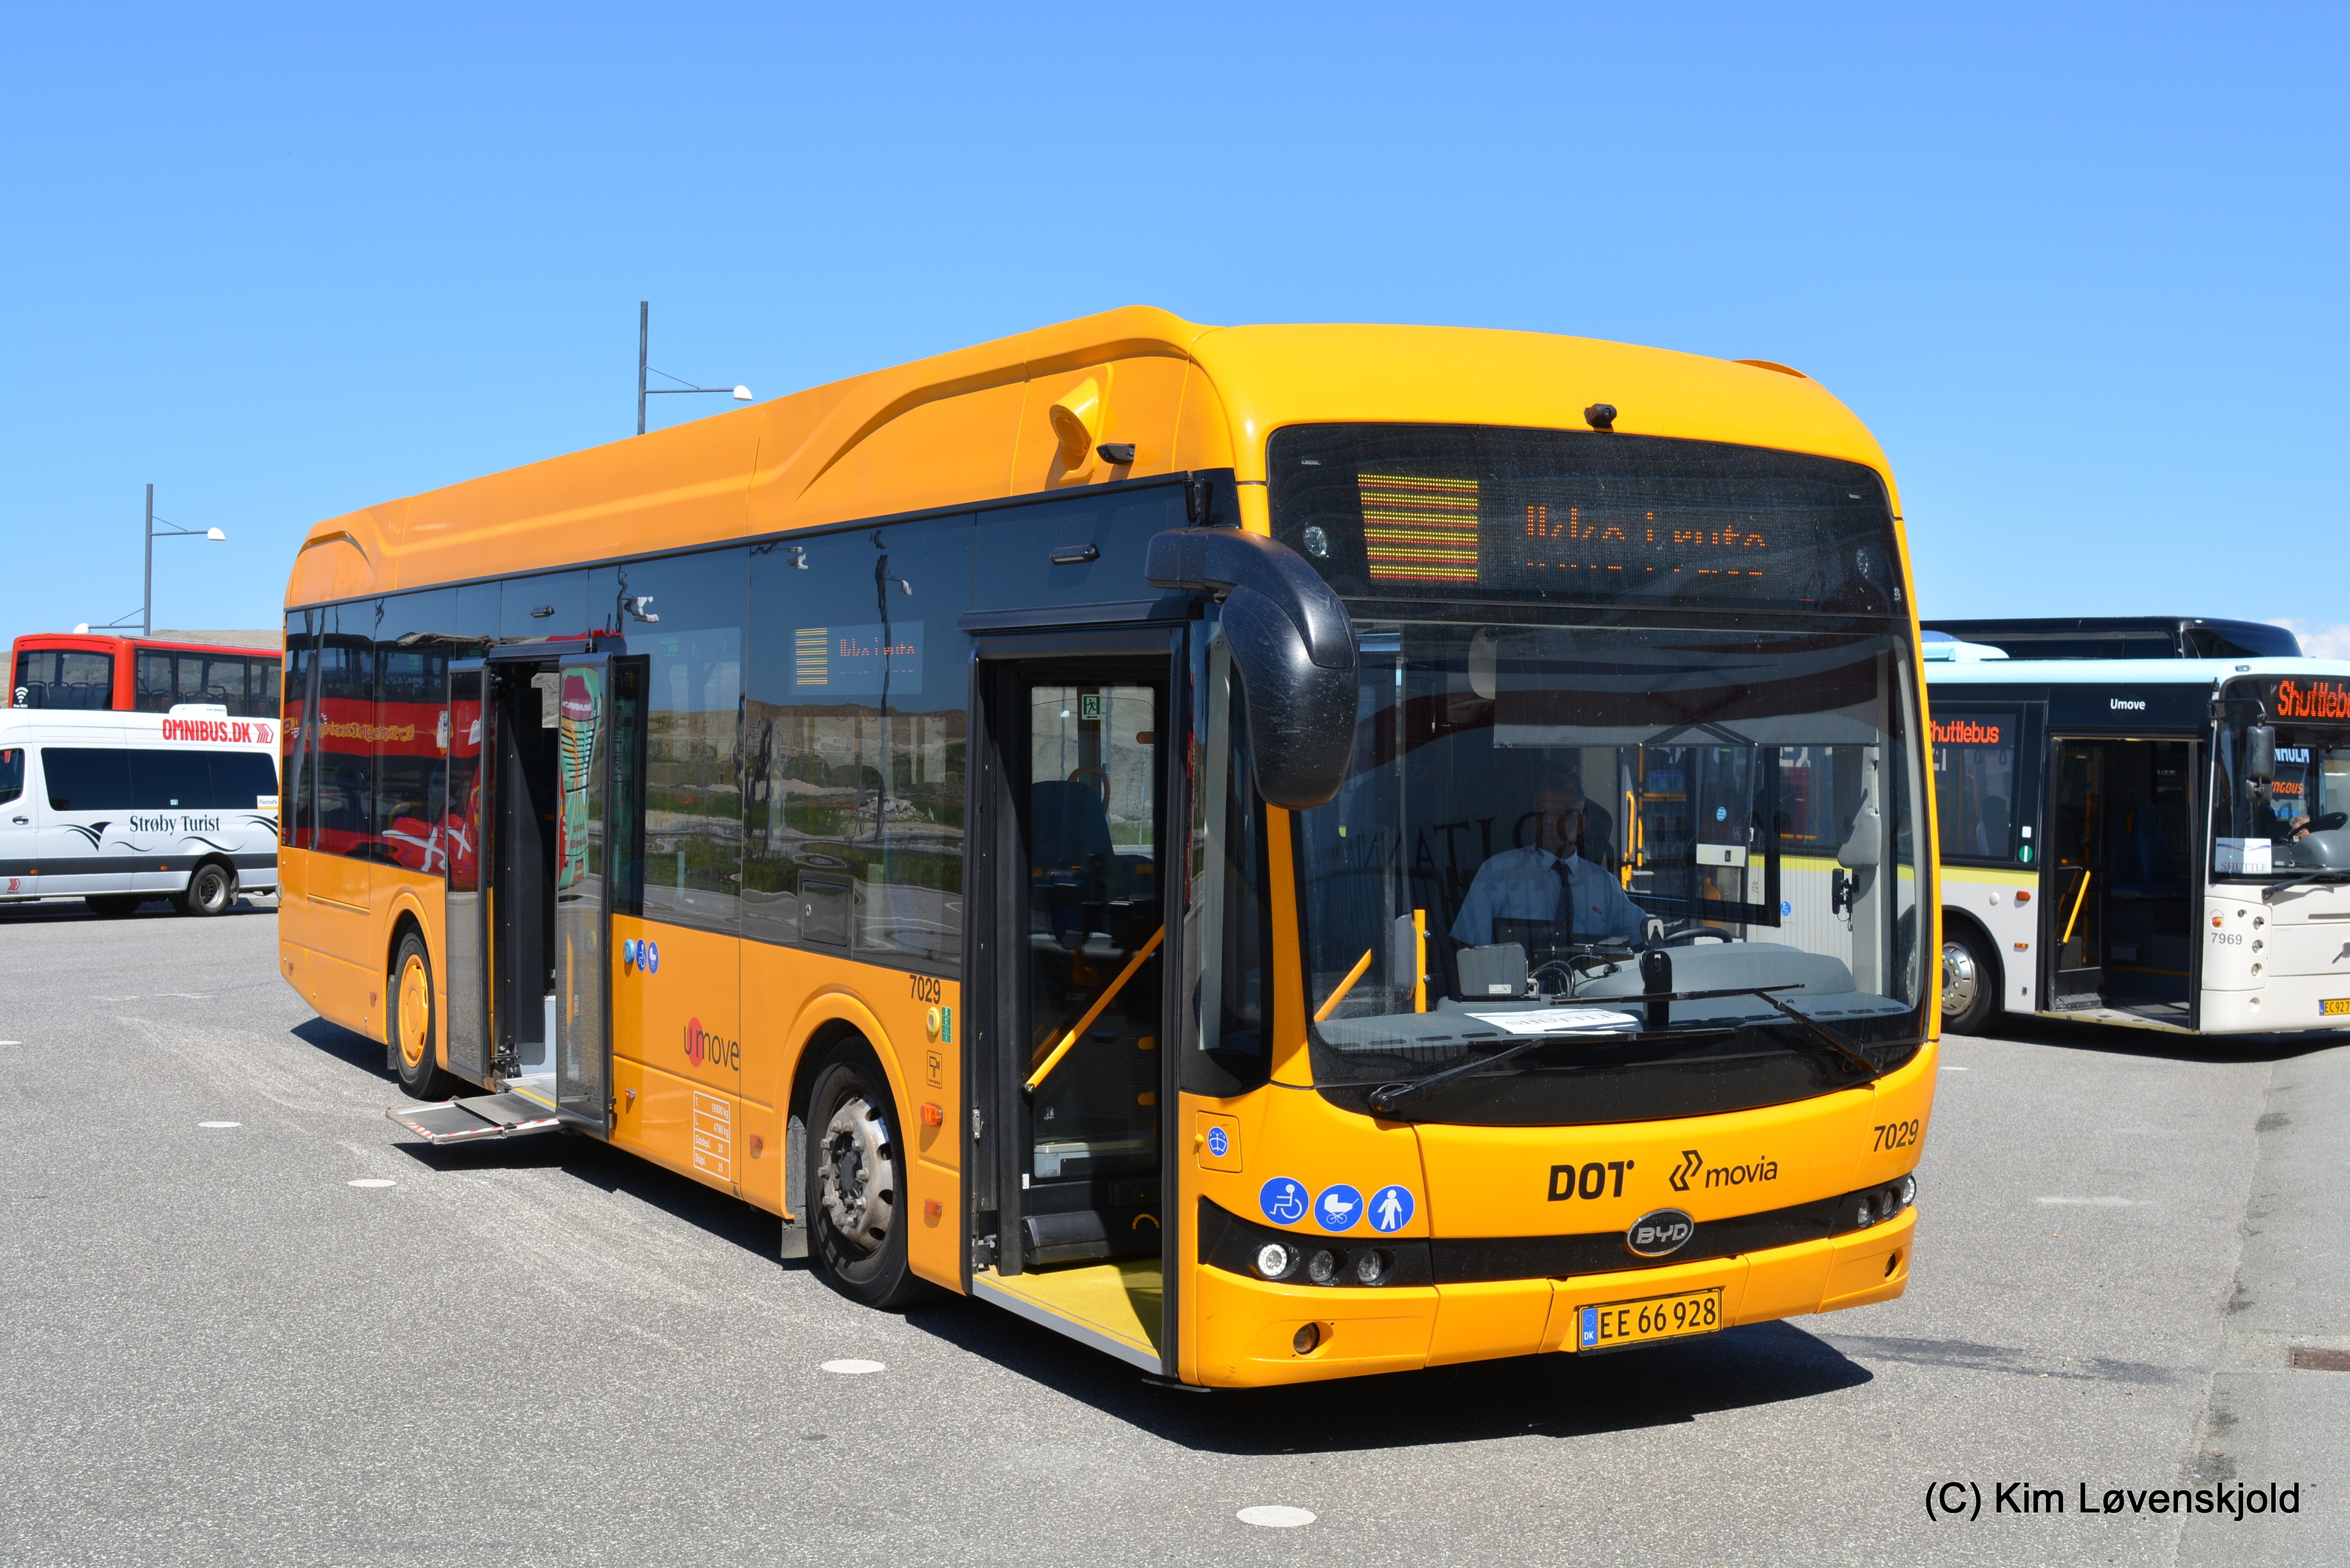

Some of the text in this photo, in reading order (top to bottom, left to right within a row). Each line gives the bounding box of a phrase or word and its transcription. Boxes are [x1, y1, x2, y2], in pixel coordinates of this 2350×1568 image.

[2110, 698, 2146, 710] Umove
[162, 719, 252, 742] OMNIBUS.DK
[2274, 748, 2310, 764] NHOLM
[130, 814, 220, 836] Strøby Turist
[2221, 862, 2267, 872] SHUTTLE
[2211, 932, 2242, 945] 7969
[909, 974, 941, 1004] 7029
[1506, 1014, 1619, 1026] SHUTTLE
[684, 1026, 739, 1072] umove
[711, 1103, 723, 1115] 19500
[723, 1107, 729, 1119] kg
[723, 1126, 729, 1139] kg
[1873, 1119, 1919, 1152] 7029
[695, 1135, 723, 1153] Siddepl. 35
[718, 1162, 723, 1172] 35
[1705, 1155, 1778, 1189] movia
[1547, 1160, 1635, 1201] DOT
[1636, 1223, 1688, 1244] BYD
[1600, 1297, 1716, 1339] EE 66 928
[1584, 1331, 1594, 1340] DK
